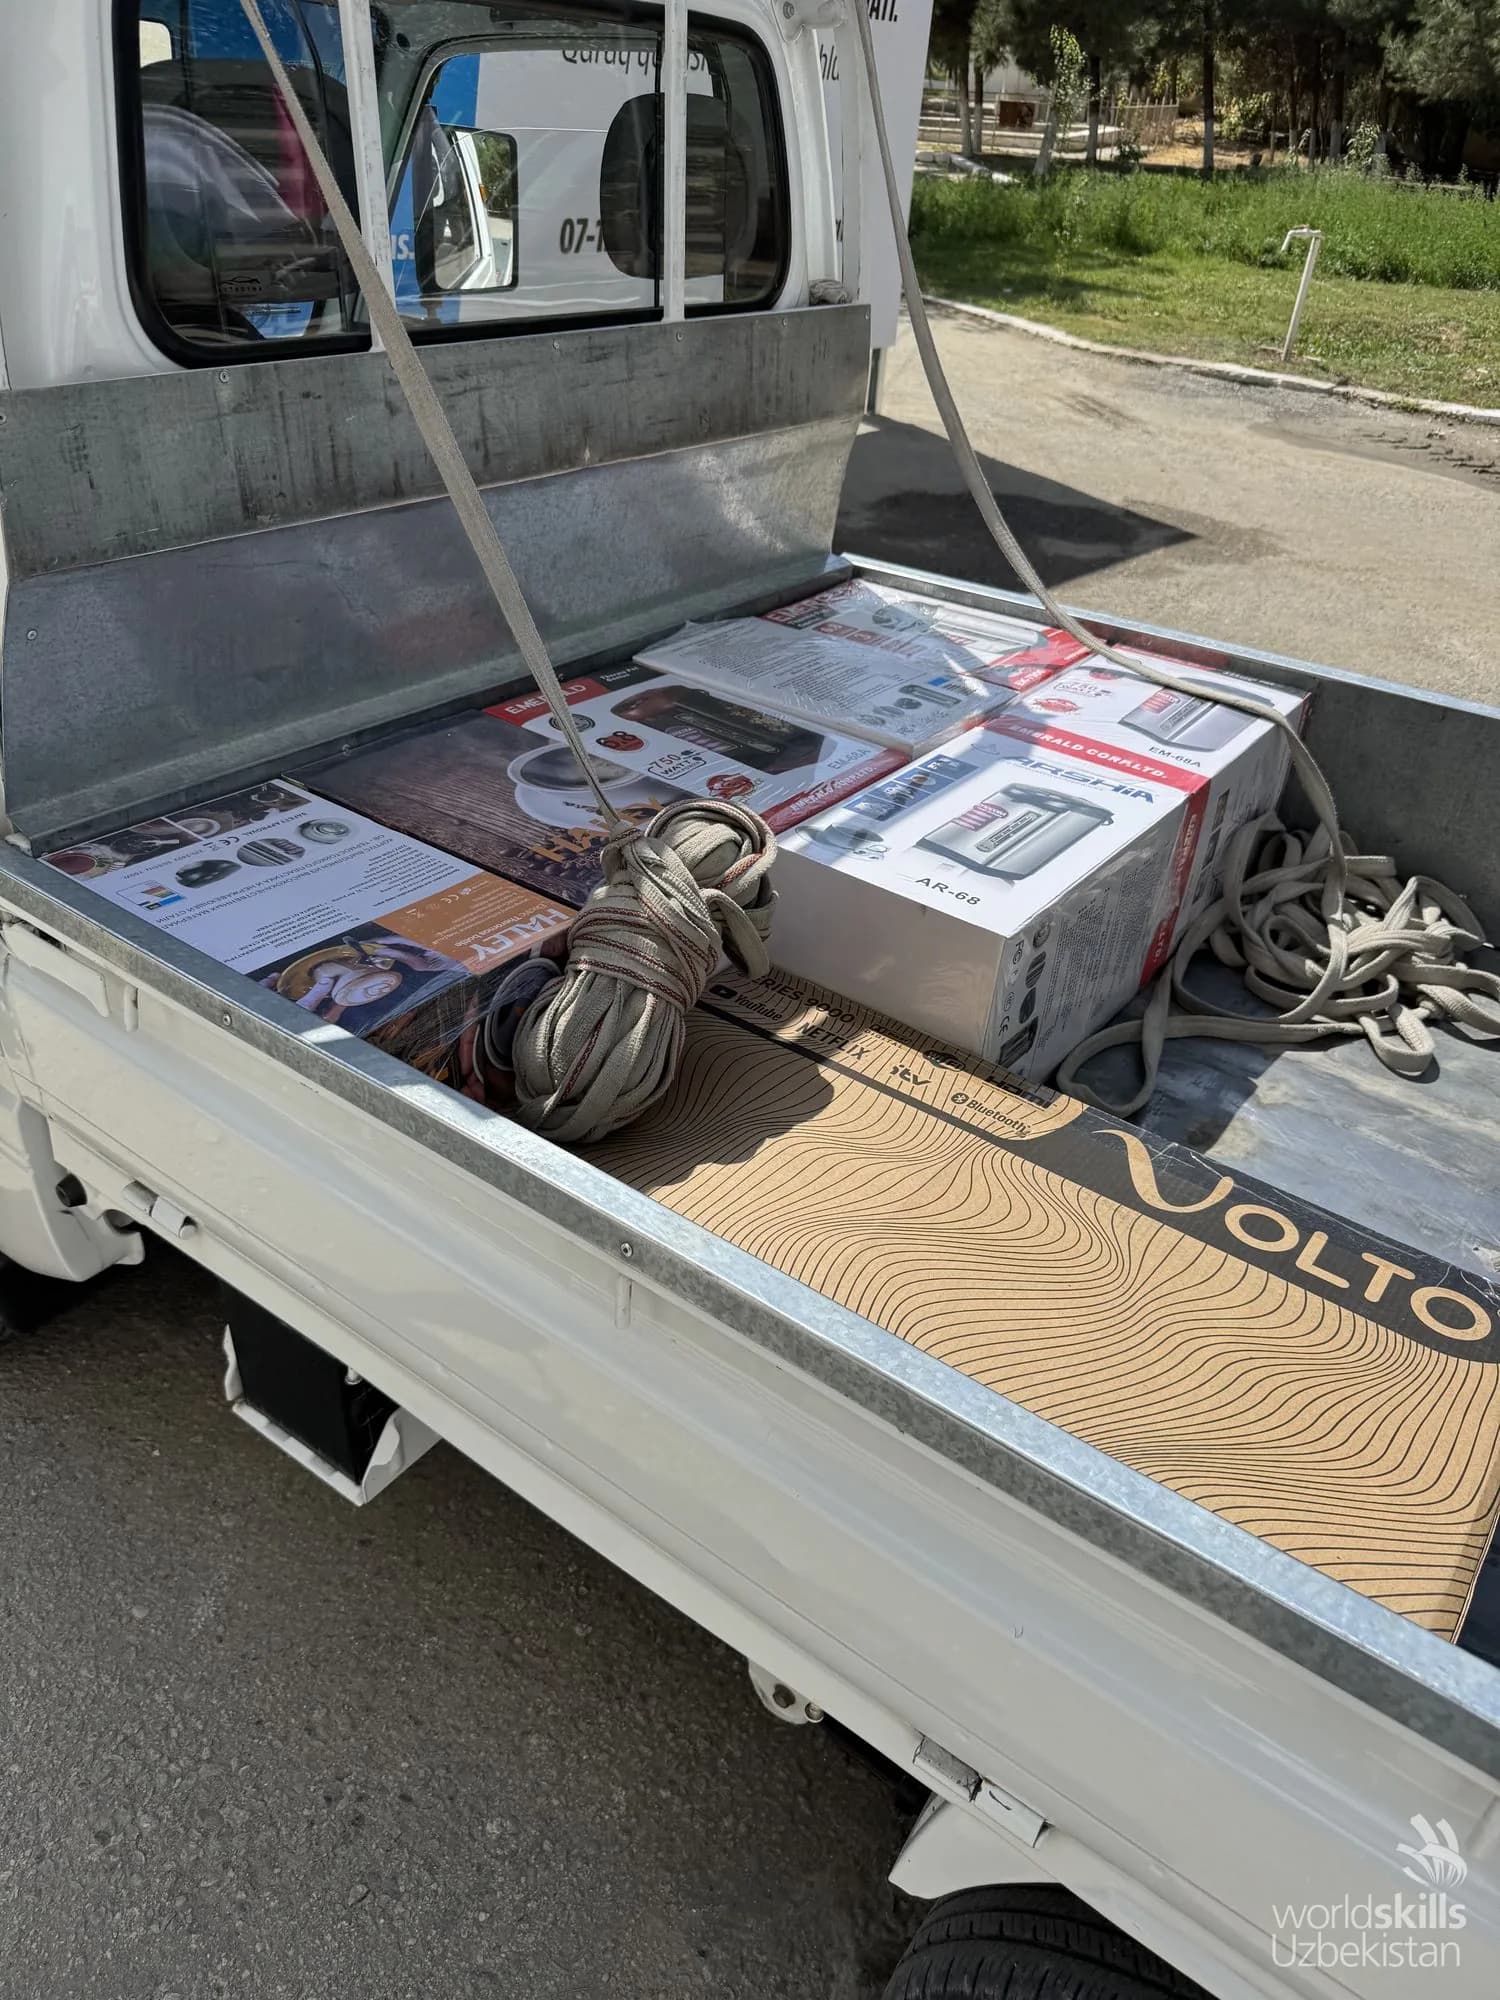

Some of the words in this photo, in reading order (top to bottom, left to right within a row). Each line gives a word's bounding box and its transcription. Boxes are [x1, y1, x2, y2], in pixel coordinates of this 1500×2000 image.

[504, 684, 587, 715] EMERLD
[1149, 746, 1201, 769] EM-68A
[914, 877, 981, 906] AR-68
[471, 907, 570, 962] HALEY
[734, 993, 783, 1022] YouTube
[751, 976, 804, 1001] RIES
[804, 997, 856, 1023] 9000
[795, 1021, 872, 1061] NETFLIX
[966, 1099, 1028, 1133] Bluetooth
[1091, 1129, 1493, 1342] VOLTO
